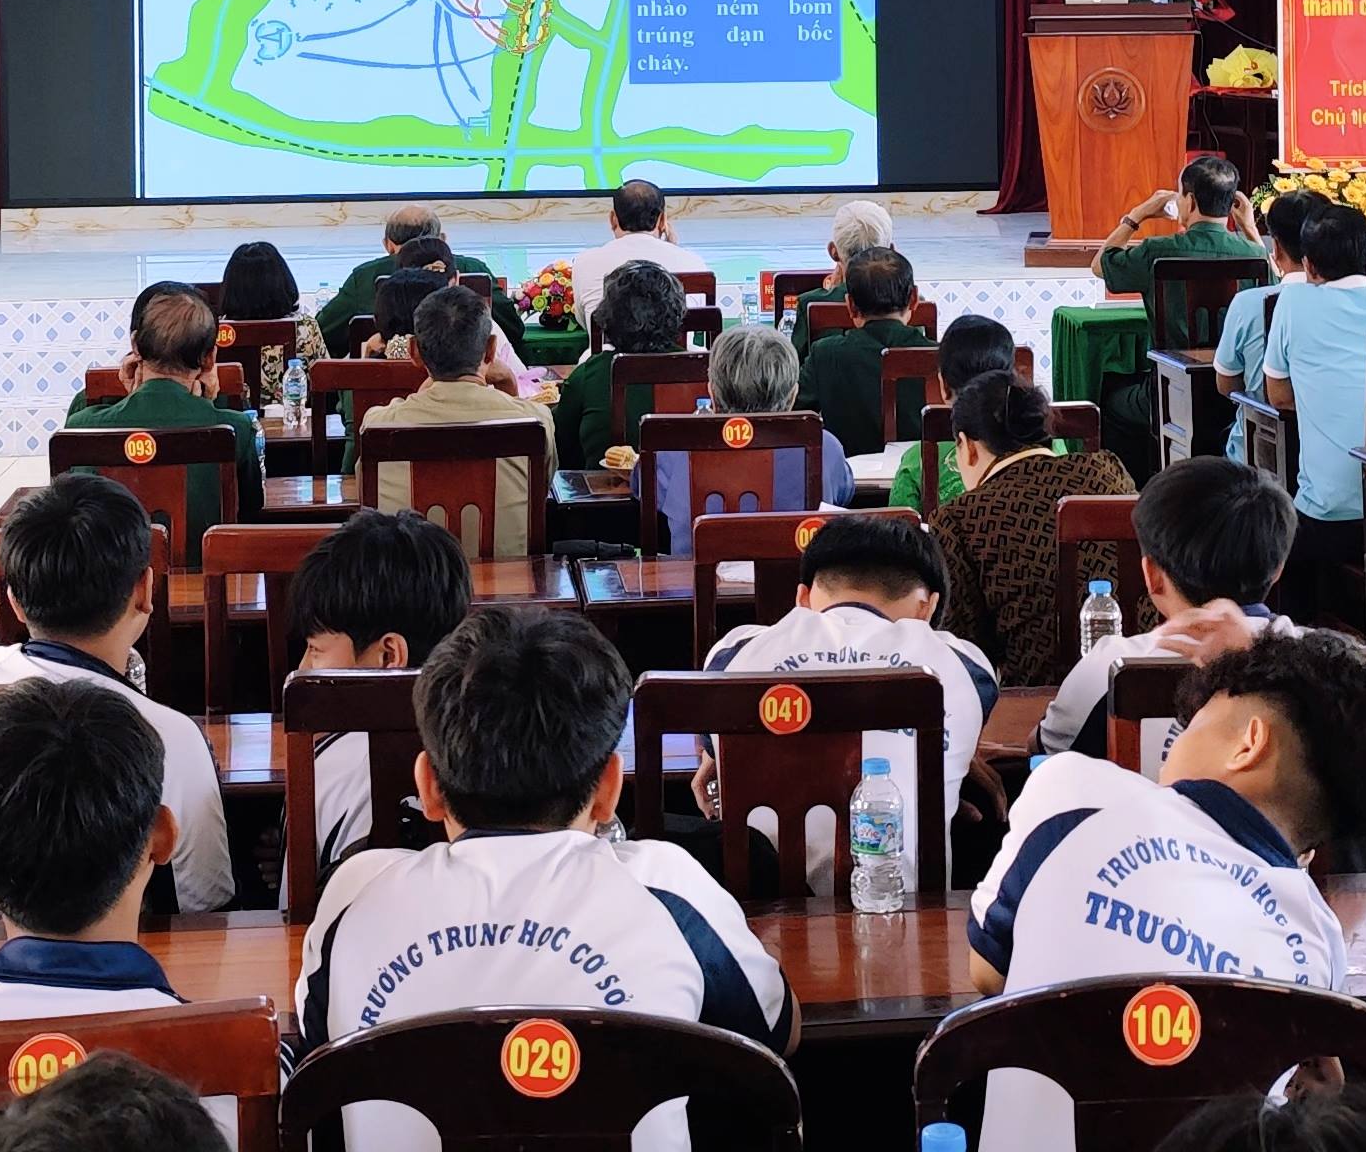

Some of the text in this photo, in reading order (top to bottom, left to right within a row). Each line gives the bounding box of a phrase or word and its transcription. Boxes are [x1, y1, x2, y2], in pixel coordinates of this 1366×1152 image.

[637, 0, 832, 17] nhào ném bom
[637, 25, 695, 47] trúng
[797, 20, 833, 42] bốc
[637, 54, 689, 74] cháy.
[725, 424, 750, 440] 012
[127, 439, 153, 457] 093
[765, 696, 803, 723] 041
[1085, 891, 1241, 975] TRƯỜNG
[358, 942, 425, 1030] RƯỜNG
[518, 918, 571, 952] HỌC
[569, 942, 610, 975] CƠ
[1133, 1004, 1193, 1046] 104
[509, 1036, 572, 1080] 029
